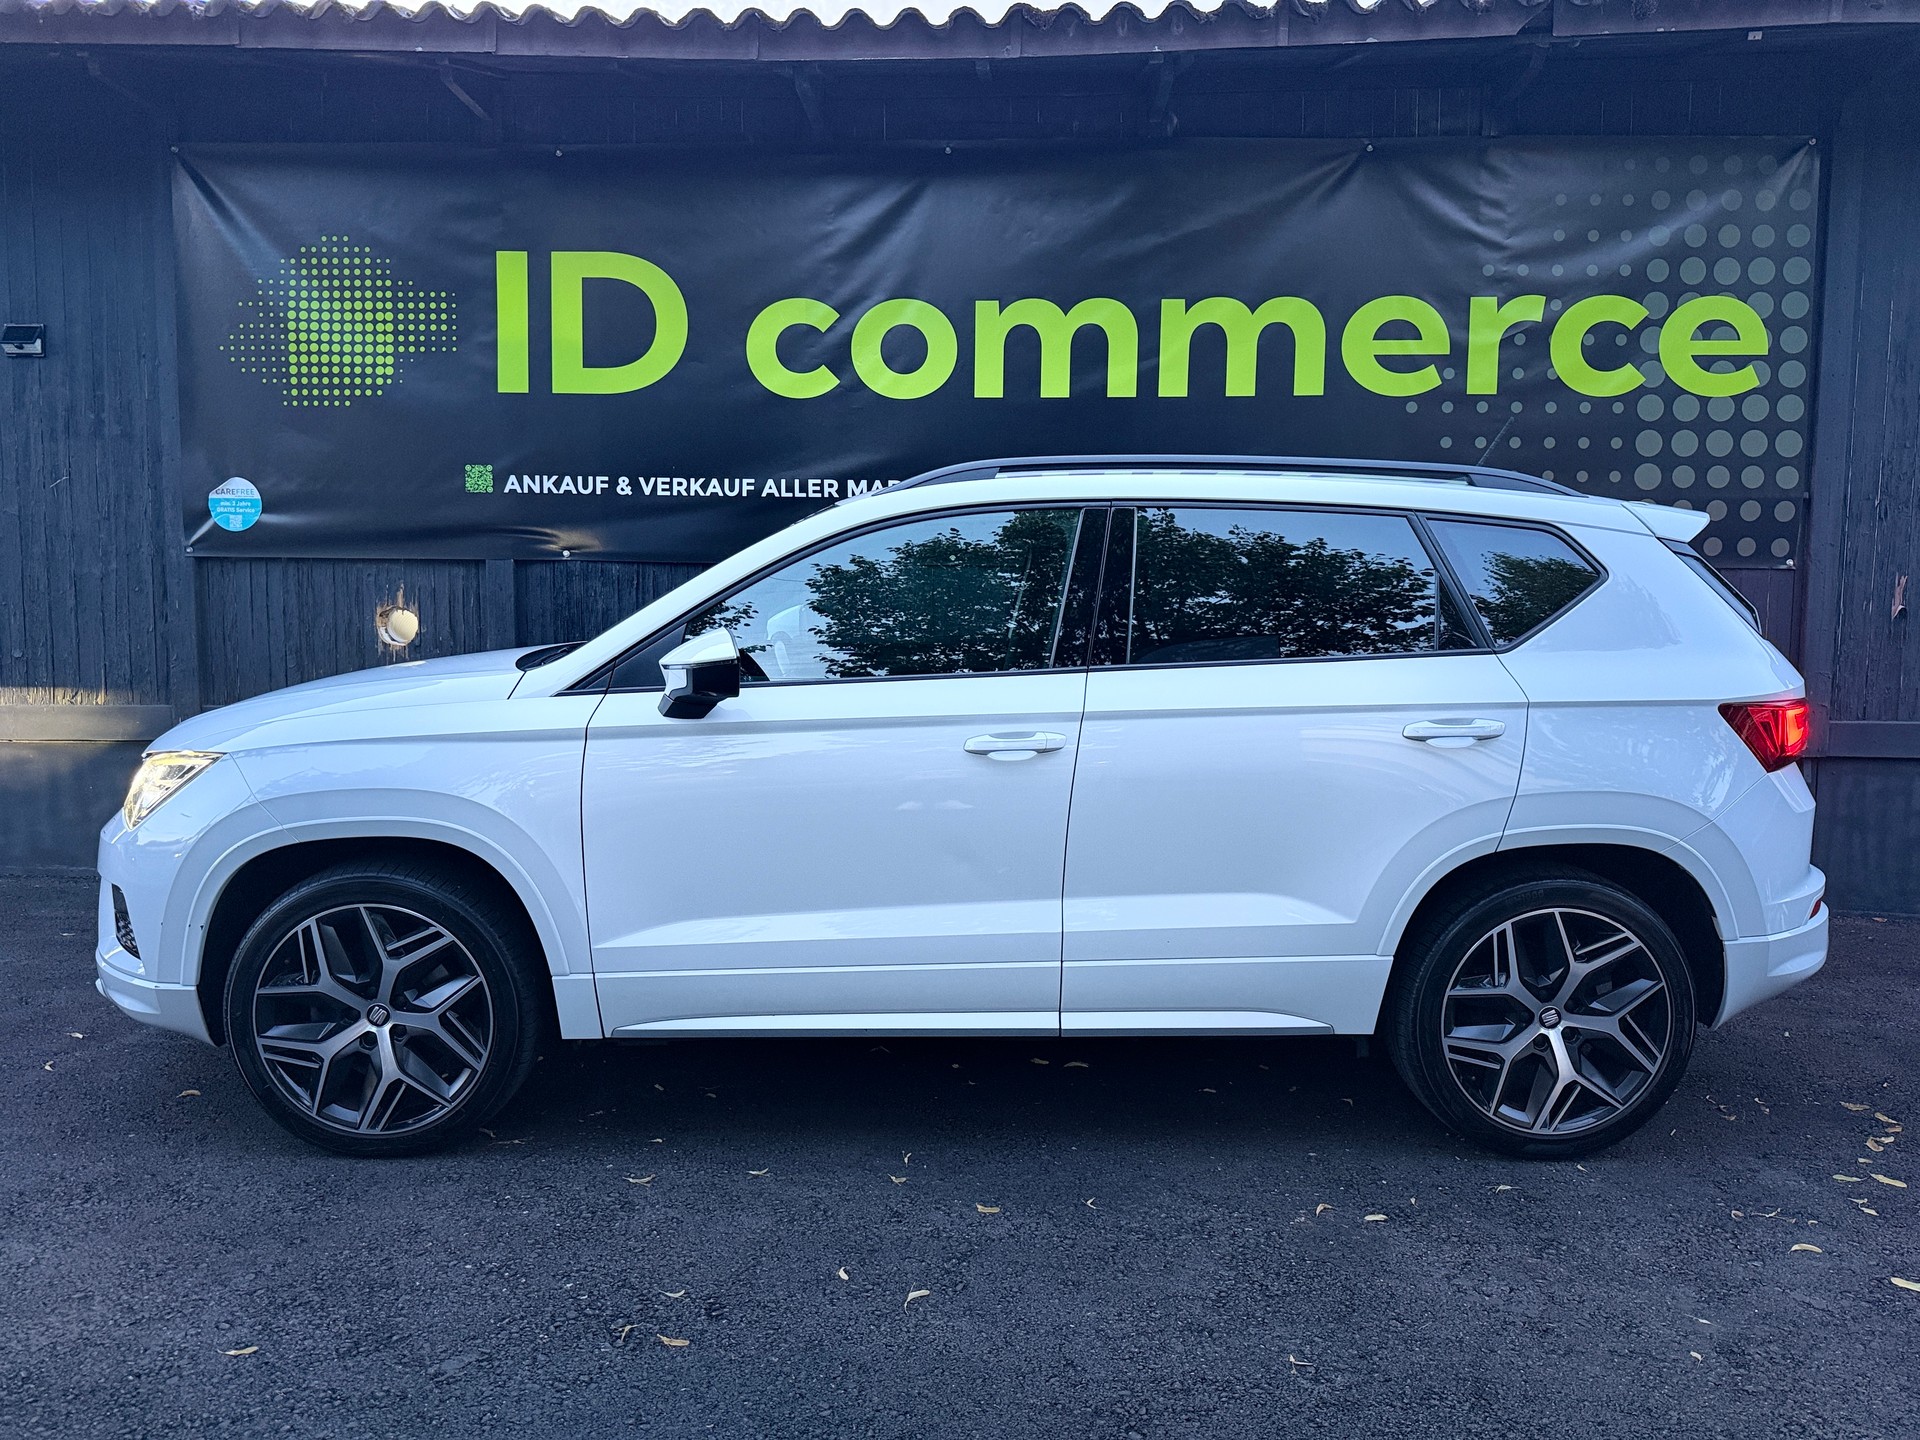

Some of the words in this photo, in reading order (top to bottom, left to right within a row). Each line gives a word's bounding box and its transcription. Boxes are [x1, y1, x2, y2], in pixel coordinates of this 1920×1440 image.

[495, 250, 688, 395] ID
[746, 294, 1769, 399] commerce
[215, 488, 255, 496] CAREFREE
[503, 474, 609, 495] ANKAUF
[616, 476, 633, 496] &
[638, 476, 756, 497] VERKAUF
[761, 478, 840, 498] ALLER
